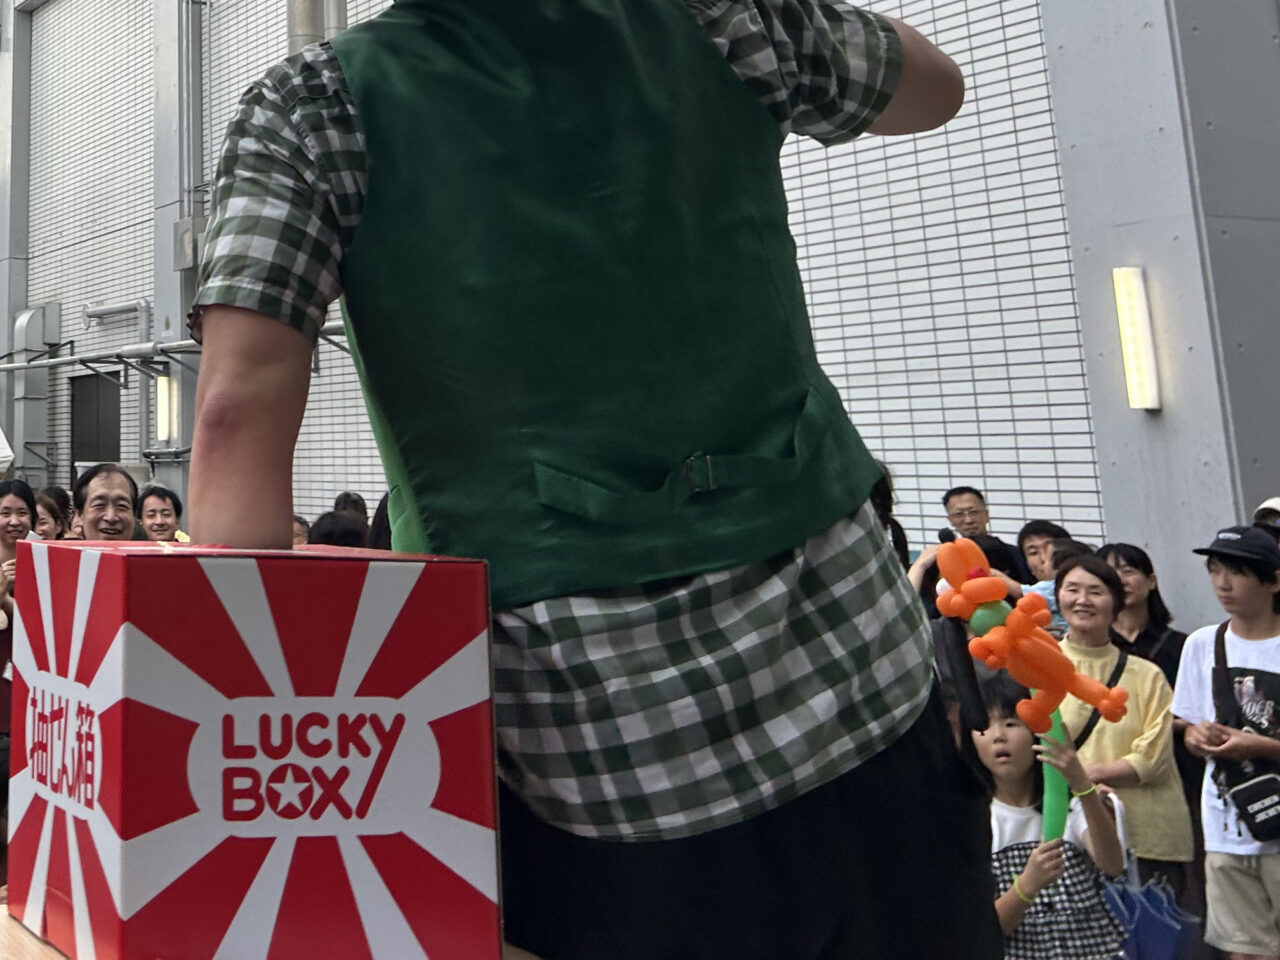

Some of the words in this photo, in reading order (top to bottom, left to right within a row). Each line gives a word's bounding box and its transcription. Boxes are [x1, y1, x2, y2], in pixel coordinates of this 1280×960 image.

[30, 686, 95, 811] 抽せん箱
[222, 712, 406, 820] LUCKY
[222, 763, 353, 822] BOX
